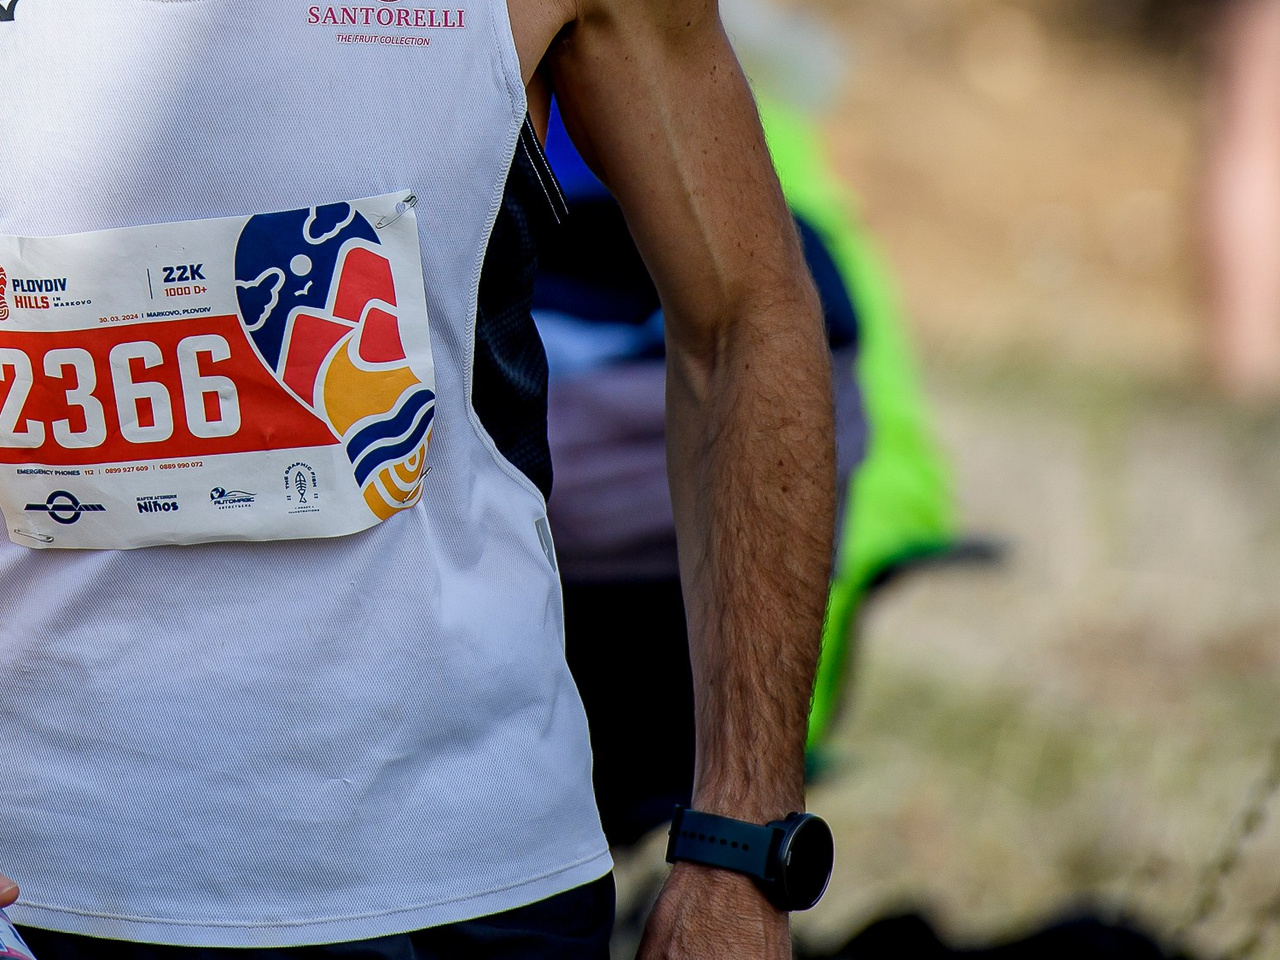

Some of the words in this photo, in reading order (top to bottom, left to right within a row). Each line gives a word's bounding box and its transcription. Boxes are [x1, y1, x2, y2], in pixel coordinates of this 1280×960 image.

[307, 6, 466, 29] SANTORELLI
[336, 34, 353, 43] THE
[354, 34, 379, 44] FRUIT
[379, 36, 431, 46] COLLECTION
[162, 263, 207, 283] 22K
[11, 277, 68, 293] PLOVDIV
[164, 285, 191, 297] 1000
[193, 285, 208, 295] D+
[13, 295, 50, 309] HILLS
[53, 299, 92, 307] MARKOVO
[182, 306, 212, 315] PLOVDIV
[121, 313, 139, 321] 2024
[16, 468, 53, 476] EMERGENCY
